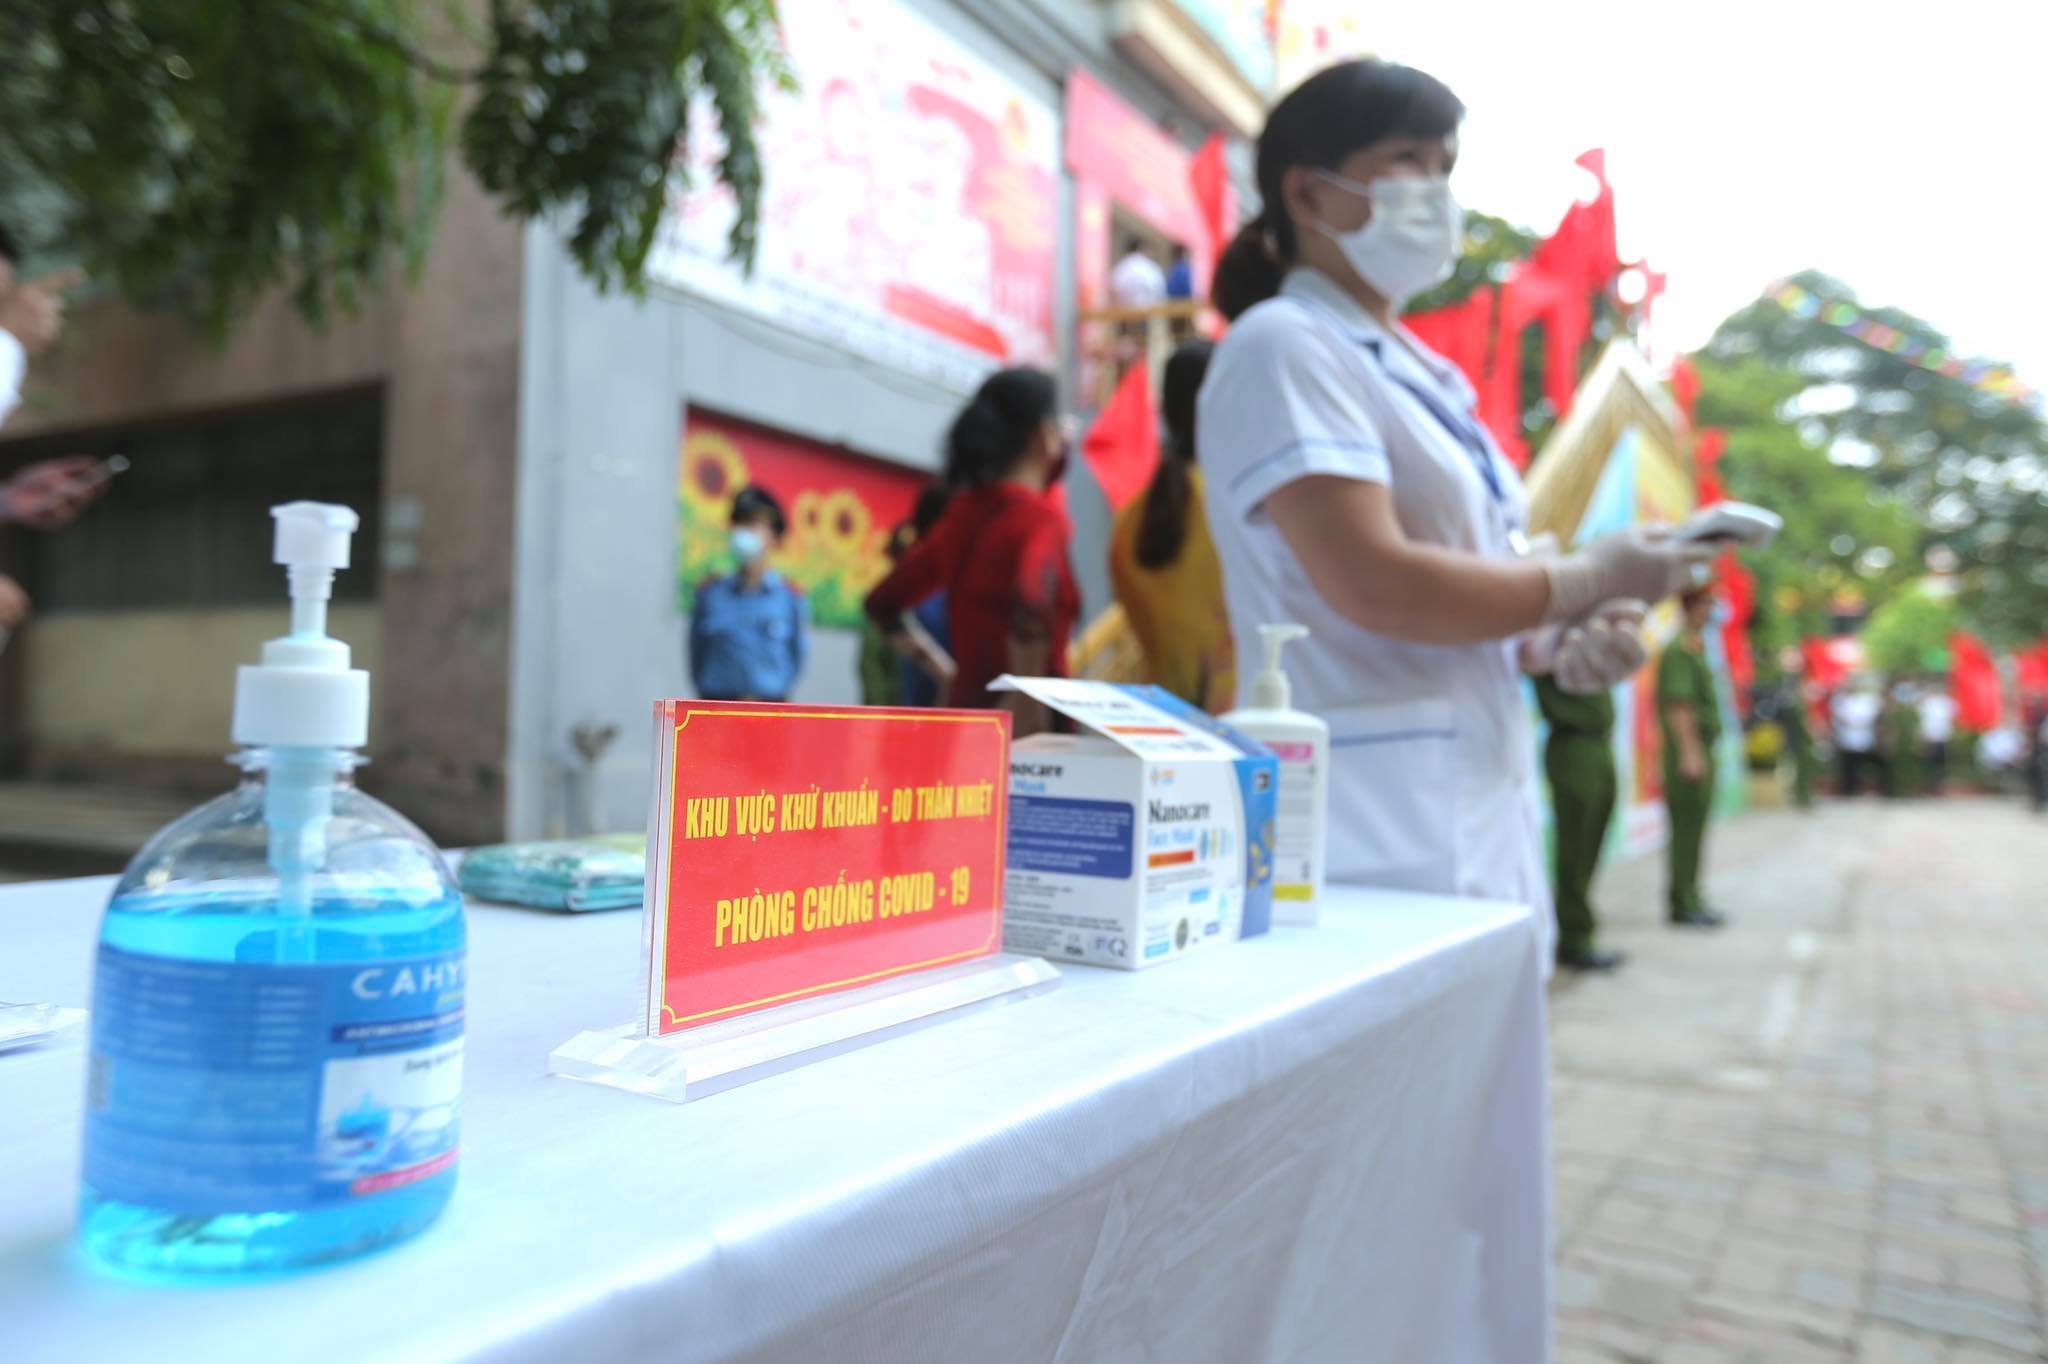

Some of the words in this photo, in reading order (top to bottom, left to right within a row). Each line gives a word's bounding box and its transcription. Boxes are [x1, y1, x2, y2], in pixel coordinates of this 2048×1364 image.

[685, 796, 729, 839] KHU
[735, 788, 776, 842] VỰC
[780, 783, 820, 832] KHỬ
[916, 780, 953, 820] THÂN
[1147, 798, 1210, 824] Nanocare
[715, 888, 795, 947] PHÒNG
[802, 869, 874, 932] CHỐNG
[879, 872, 934, 918] COVID
[950, 866, 970, 906] 19
[350, 960, 465, 1001] CAHY
